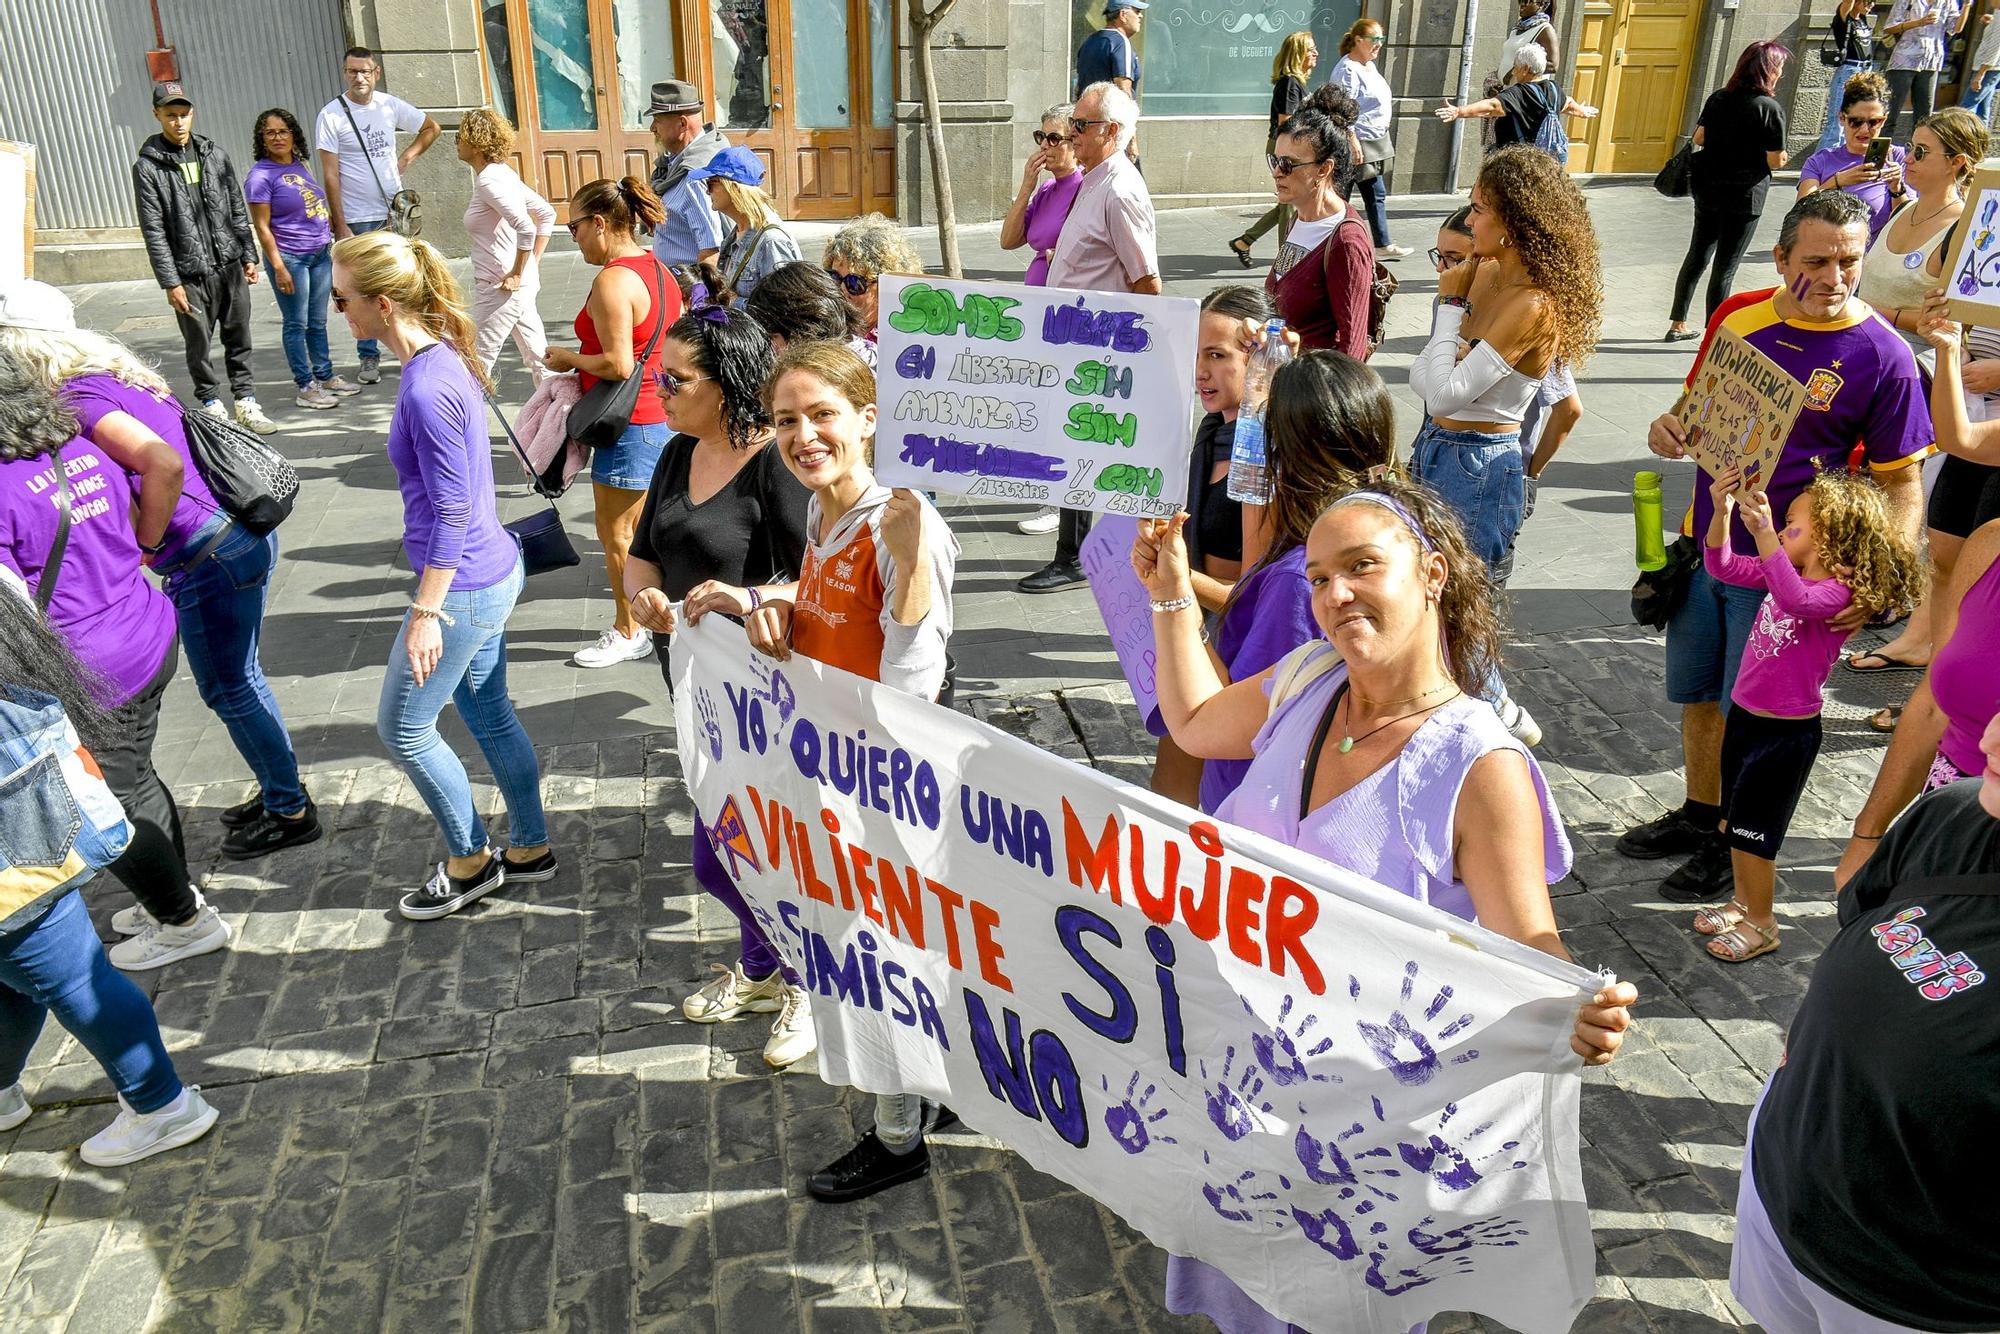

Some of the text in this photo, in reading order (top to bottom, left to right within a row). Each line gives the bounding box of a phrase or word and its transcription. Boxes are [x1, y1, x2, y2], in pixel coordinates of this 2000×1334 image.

[1228, 46, 1239, 58] DE
[889, 283, 1025, 341] SOMOS
[895, 344, 935, 380] EN
[1709, 336, 1733, 369] NO
[894, 390, 1038, 432] AMENAZAS
[1723, 379, 1760, 416] CONTRA
[1720, 406, 1741, 429] LAS
[25, 474, 49, 494] LA
[72, 473, 108, 498] HACE
[1094, 463, 1164, 497] CON
[1064, 490, 1096, 507] EN
[1106, 493, 1138, 515] LAS
[723, 682, 767, 755] YO
[960, 784, 1053, 877] UNA
[963, 987, 1090, 1149] NO
